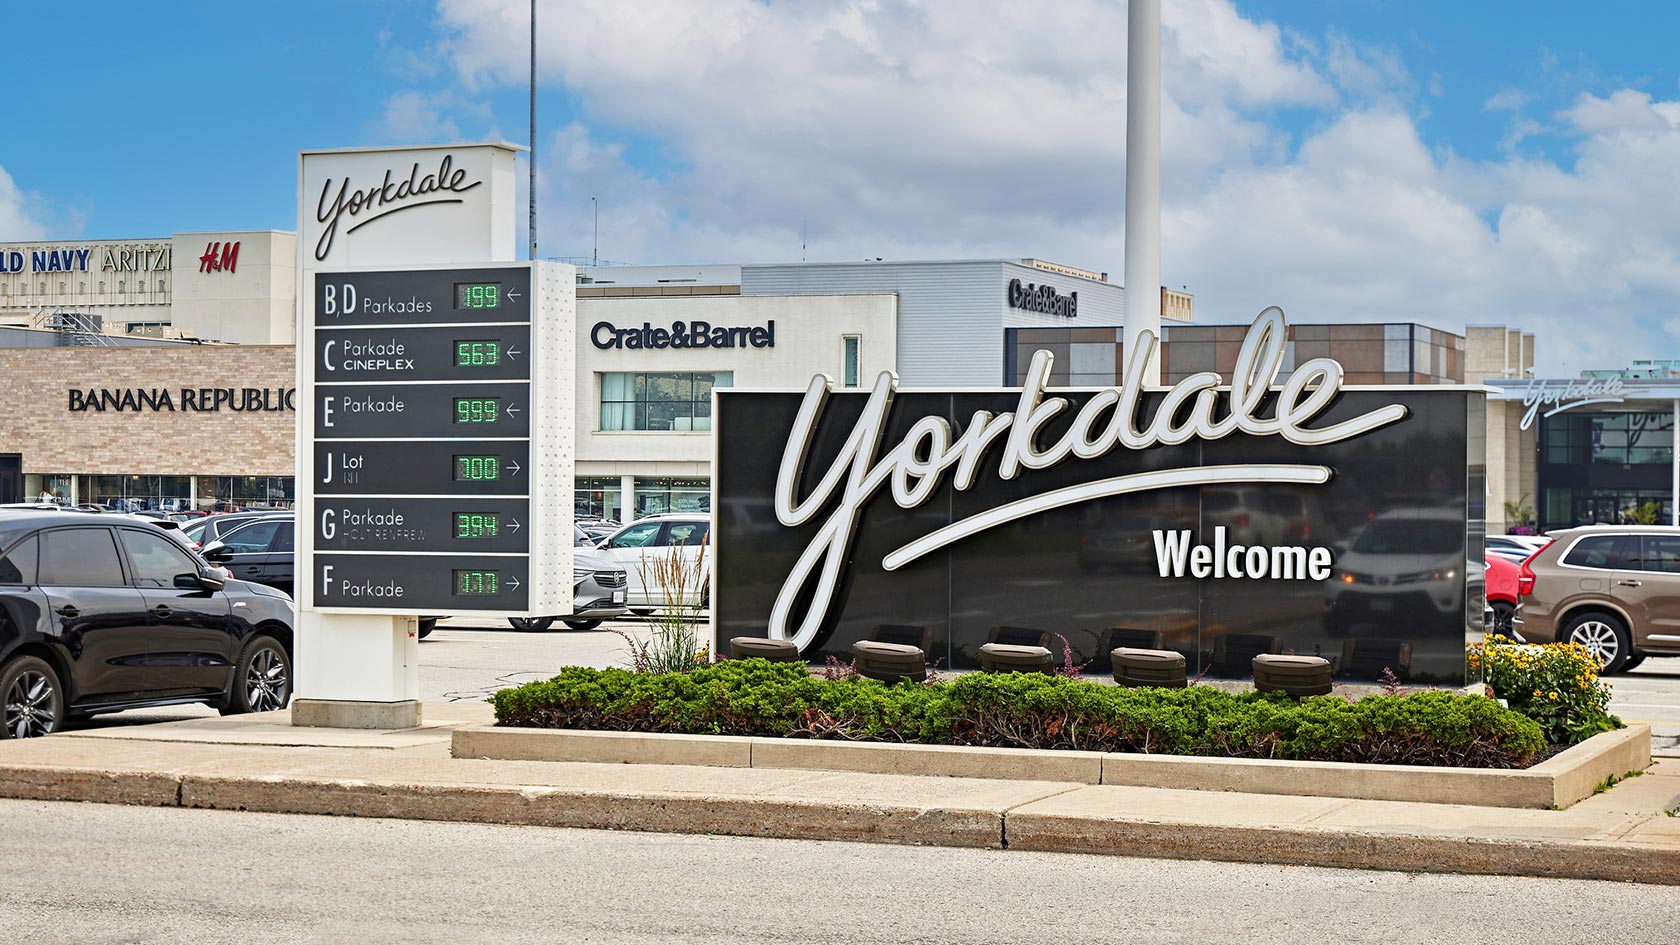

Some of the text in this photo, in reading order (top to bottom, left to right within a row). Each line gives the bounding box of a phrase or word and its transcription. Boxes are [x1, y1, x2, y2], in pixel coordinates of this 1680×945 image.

[315, 154, 482, 261] Yorkdale
[32, 248, 92, 272] NAVY
[102, 248, 172, 271] ARITZI
[199, 241, 241, 274] H&M
[325, 283, 433, 318] B,D Parkades
[465, 286, 498, 308] 199
[1008, 278, 1078, 318] Crate&Barrel
[590, 319, 776, 350] Crate&Barrel
[324, 338, 405, 372] C Parkade
[343, 359, 414, 371] CINEPLEX
[457, 343, 498, 366] 563
[68, 388, 175, 412] BANANA
[324, 395, 405, 427] E Parkade
[457, 400, 497, 423] 999
[1520, 374, 1634, 431] Yorkdale
[323, 452, 364, 484] J Lot
[458, 458, 497, 480] 700
[767, 305, 1411, 653] Yorkdale
[322, 508, 404, 540] G Parkade
[458, 515, 497, 537] 394
[1152, 526, 1333, 582] Welcome
[323, 565, 404, 597] F Parkade
[465, 573, 496, 594] 177
